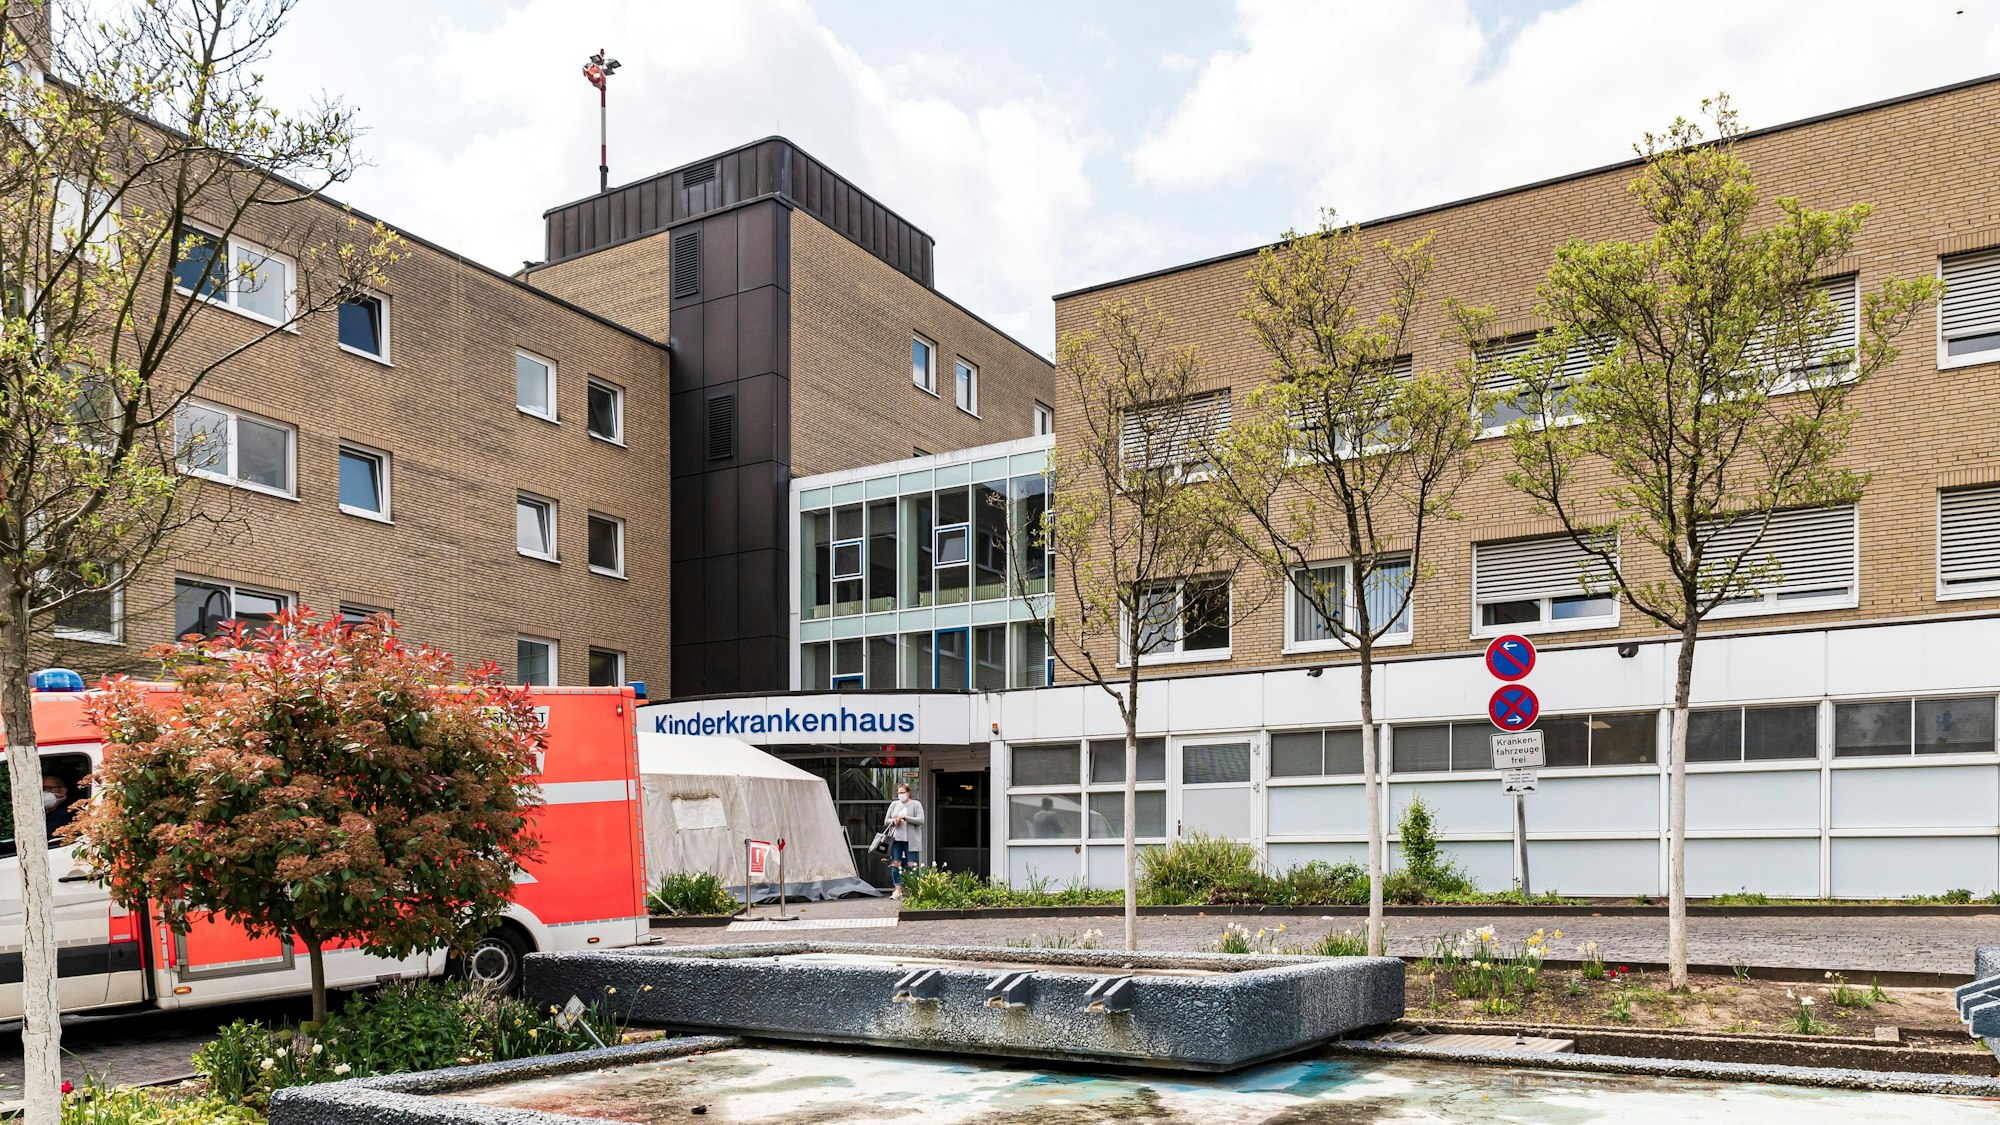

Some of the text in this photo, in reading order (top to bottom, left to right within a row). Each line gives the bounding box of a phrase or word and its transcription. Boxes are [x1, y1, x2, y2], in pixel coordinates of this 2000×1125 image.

[655, 707, 915, 736] Kinderkrankenhaus
[1496, 737, 1537, 747] Kranken-
[1496, 746, 1540, 756] fahrzeuge
[1511, 755, 1527, 764] frei
